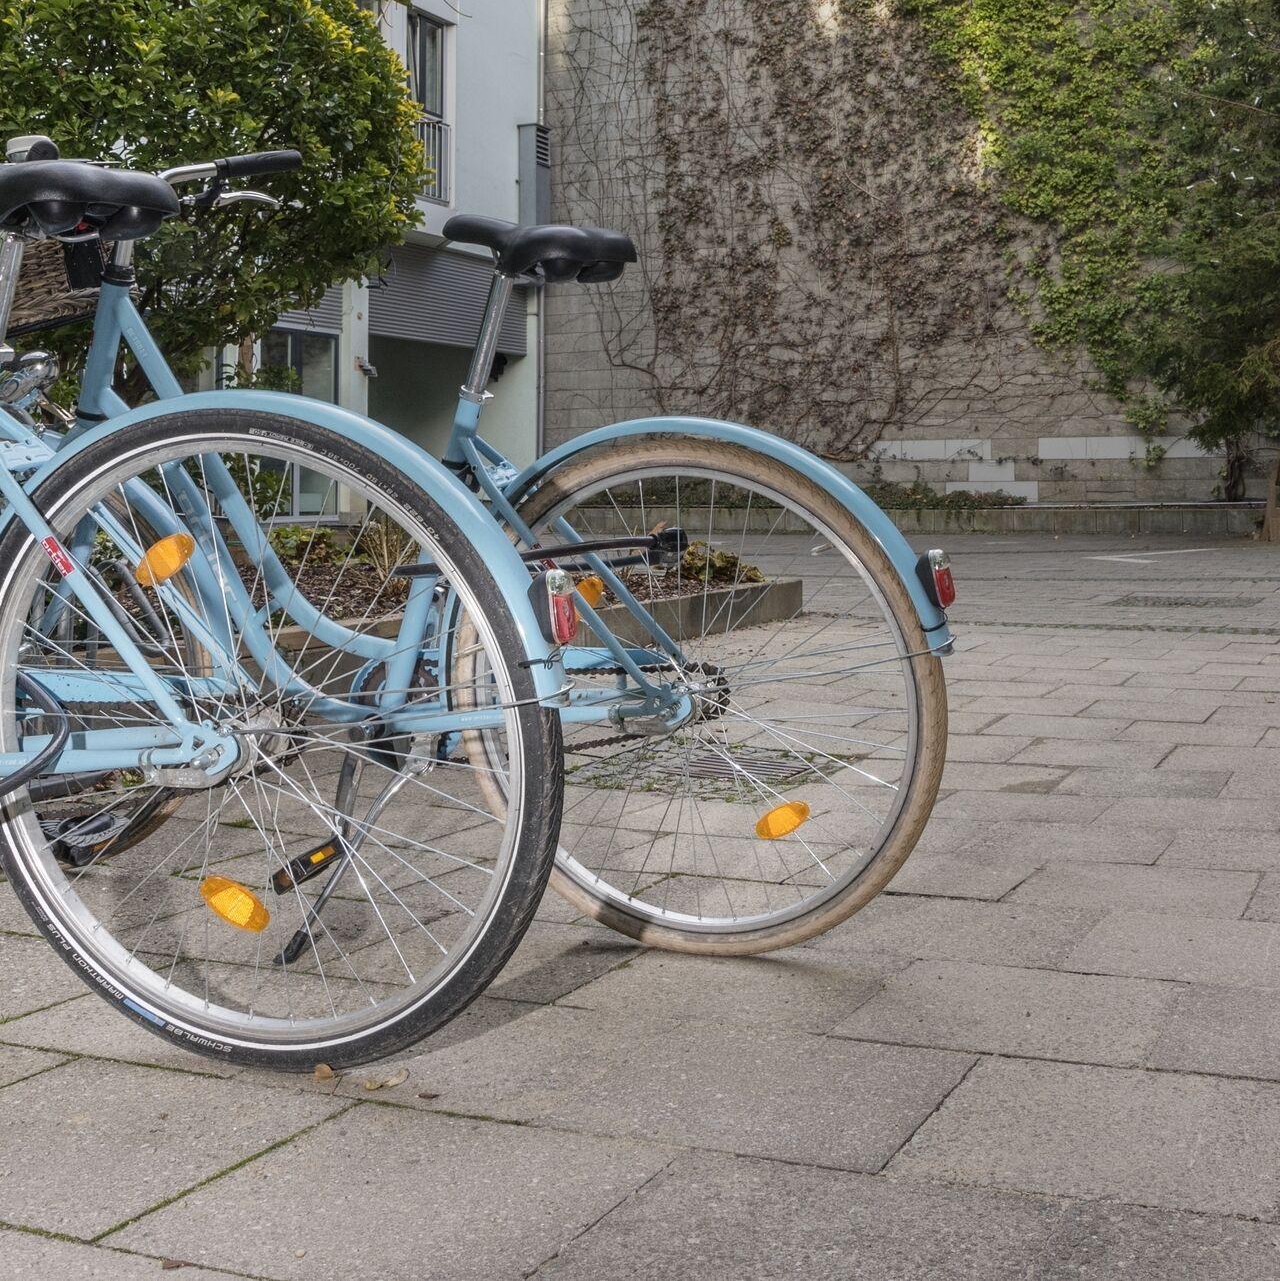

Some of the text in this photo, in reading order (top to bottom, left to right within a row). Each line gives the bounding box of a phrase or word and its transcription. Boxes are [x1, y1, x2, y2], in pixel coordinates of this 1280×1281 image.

[402, 502, 441, 541] 40-622
[42, 540, 68, 577] ortler
[46, 922, 233, 1054] SCHWALBE MARATHON PLUS
